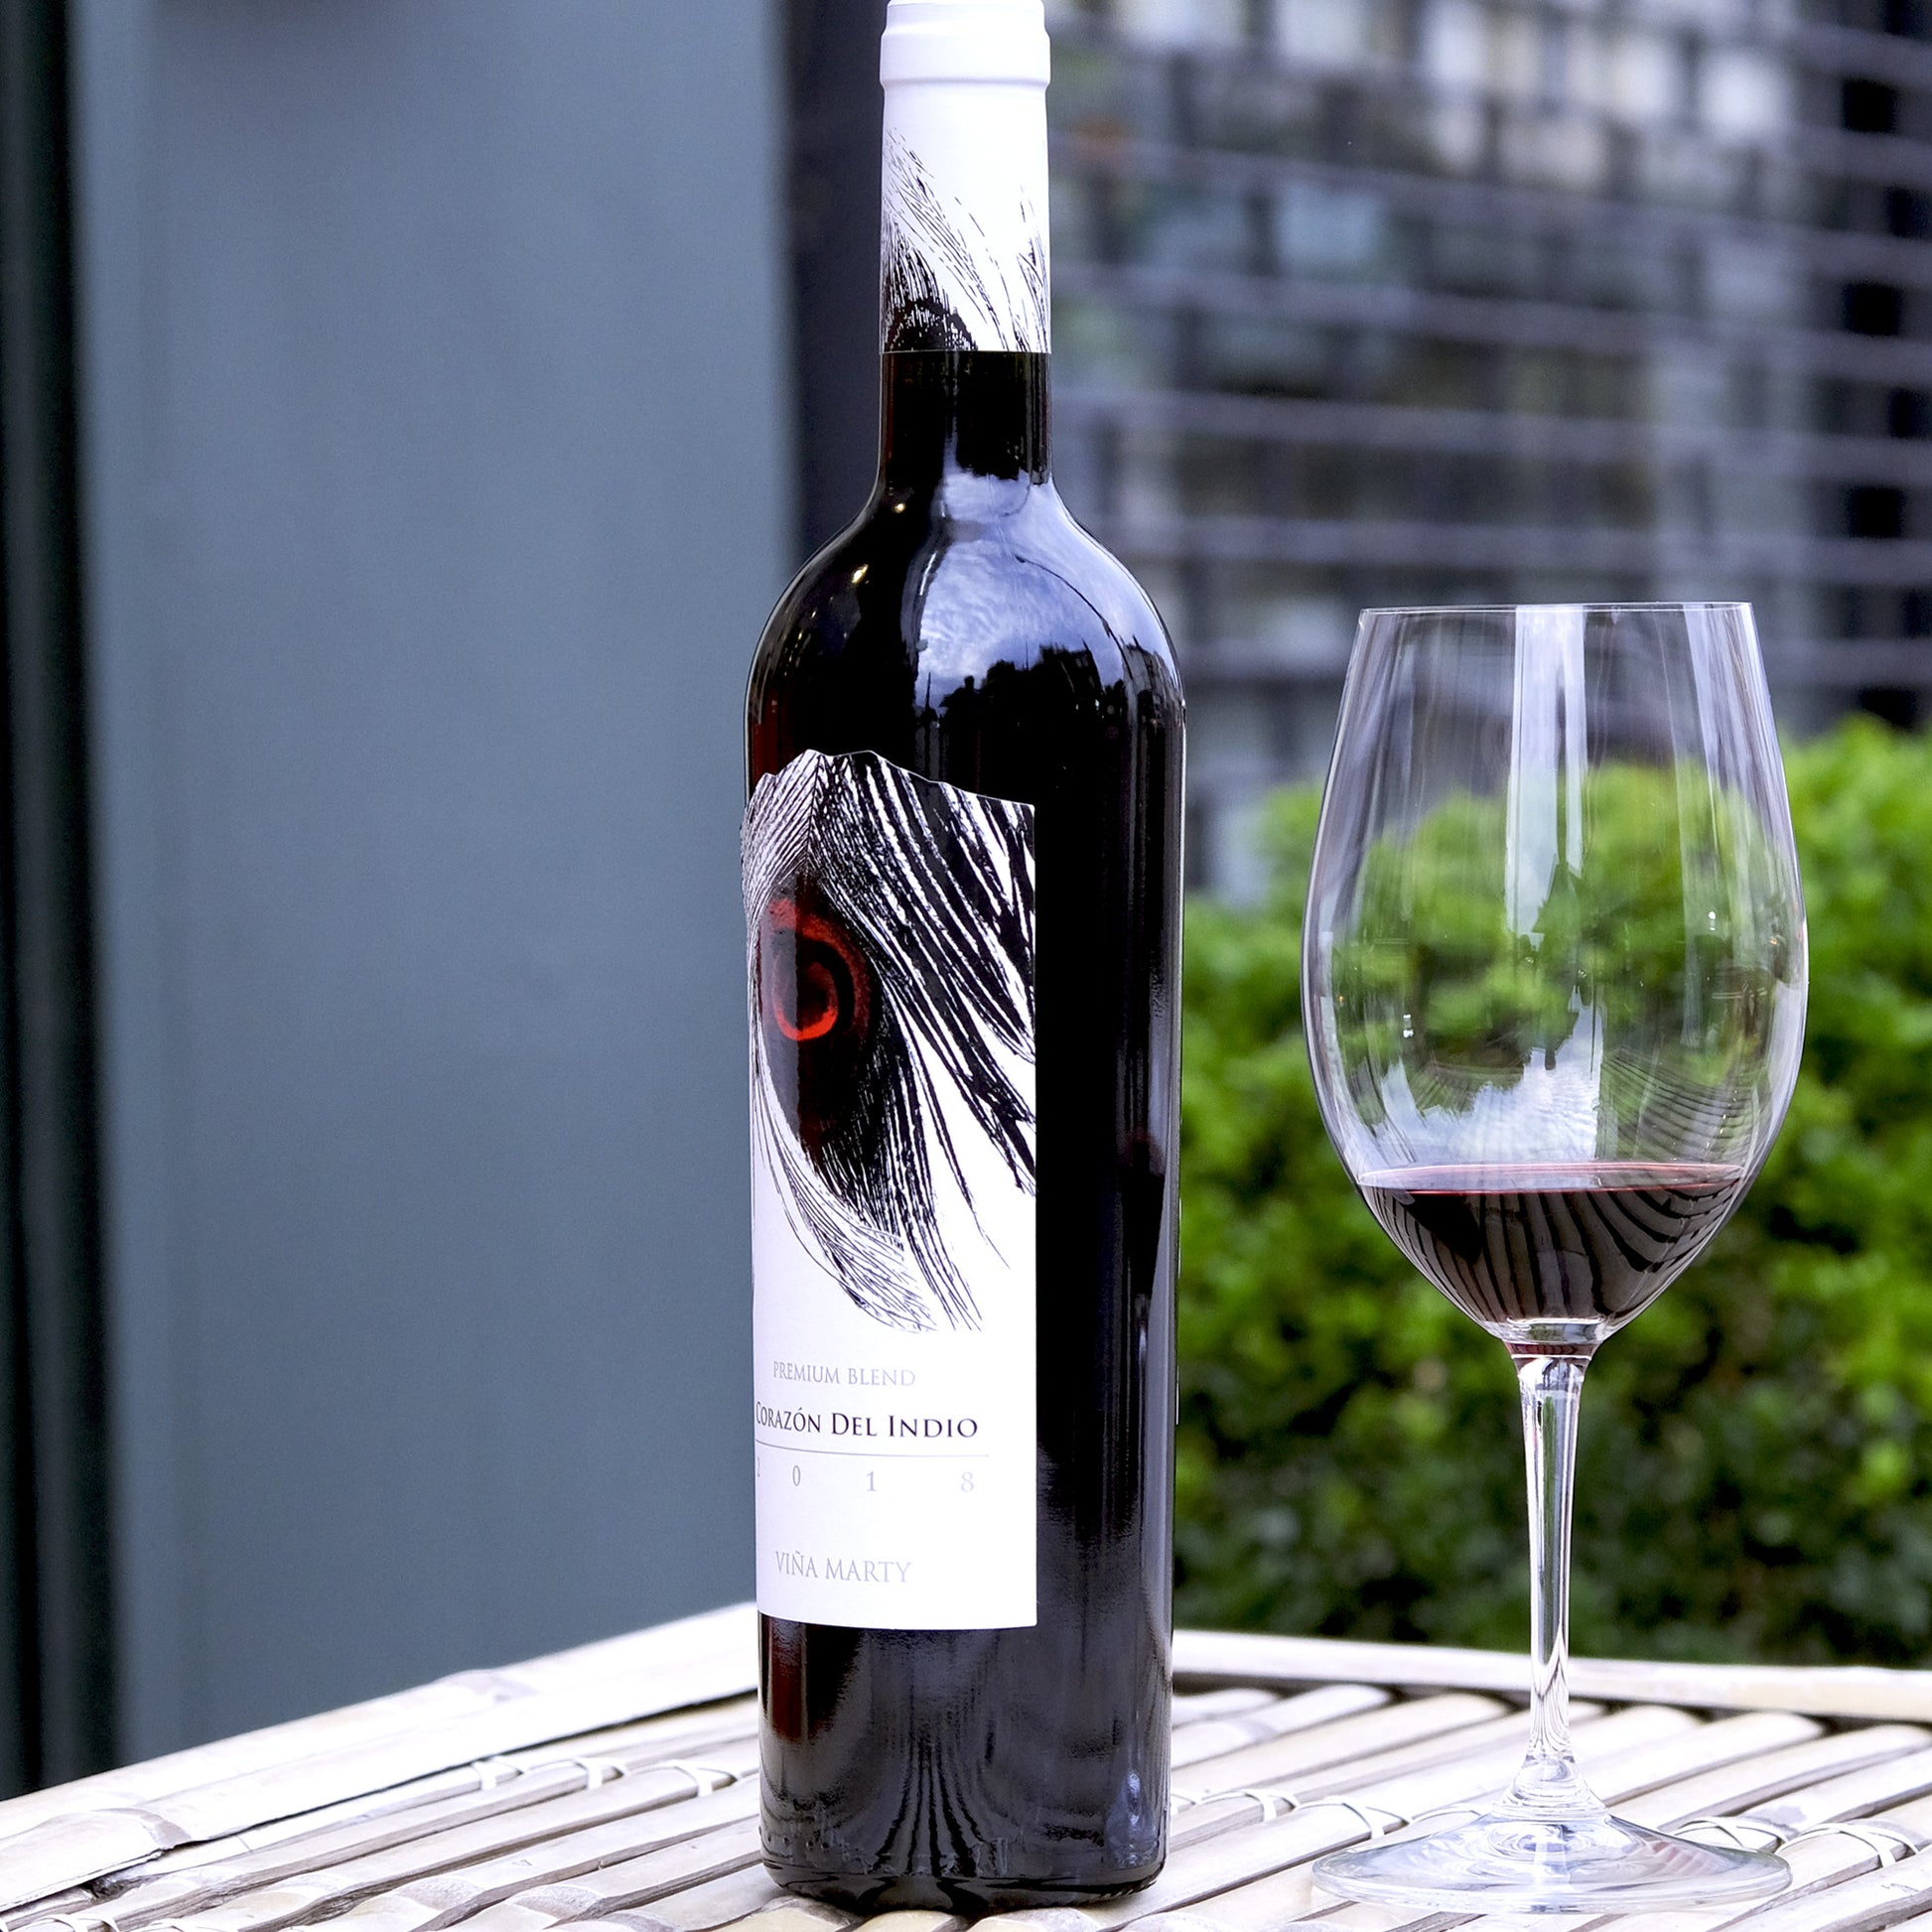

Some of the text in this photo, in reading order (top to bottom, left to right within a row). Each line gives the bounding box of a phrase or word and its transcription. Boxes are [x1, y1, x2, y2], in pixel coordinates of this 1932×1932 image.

[773, 1361, 915, 1386] PREMIUM BLEND
[775, 1551, 911, 1583] VIÑA MARTY
